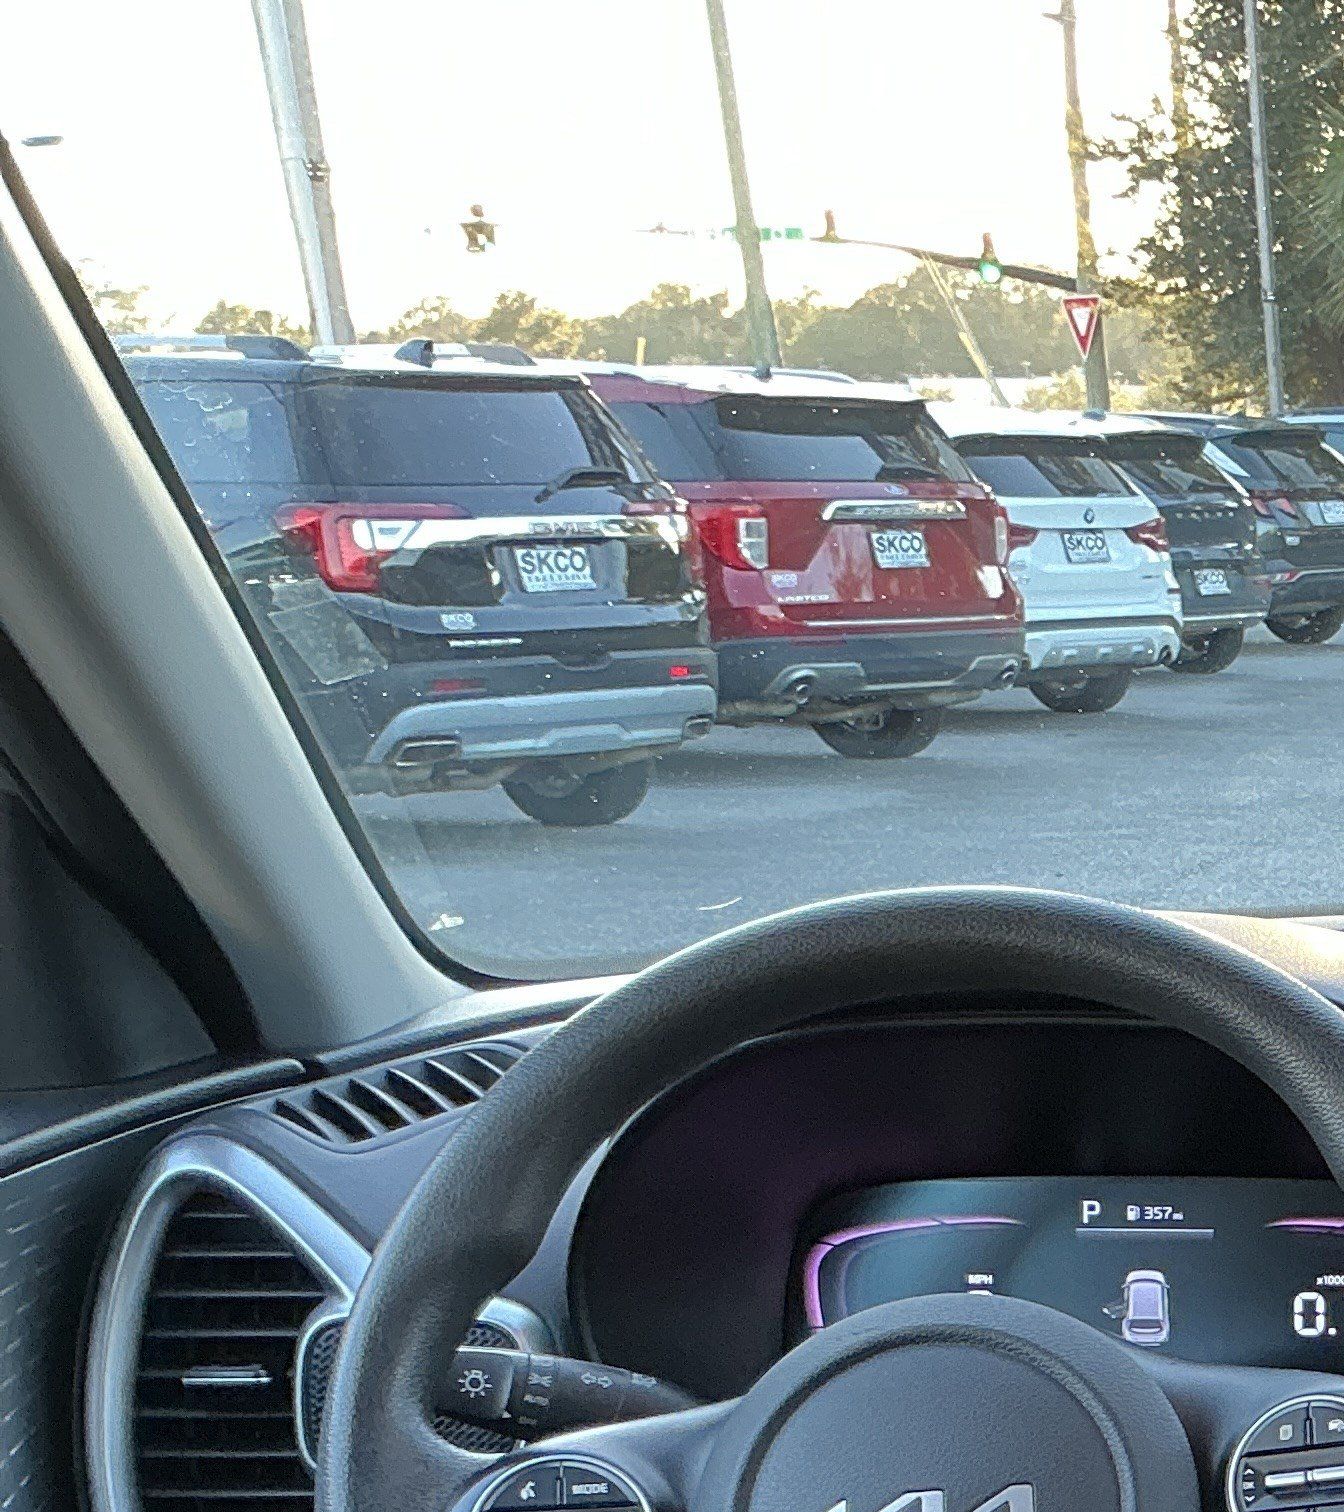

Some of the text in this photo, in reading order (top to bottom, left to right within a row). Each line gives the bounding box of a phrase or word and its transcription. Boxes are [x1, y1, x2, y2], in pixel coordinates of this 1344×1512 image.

[876, 535, 922, 553] SKCO
[1066, 536, 1105, 551] SKCO
[521, 550, 587, 575] SKCO
[1082, 1200, 1101, 1225] P
